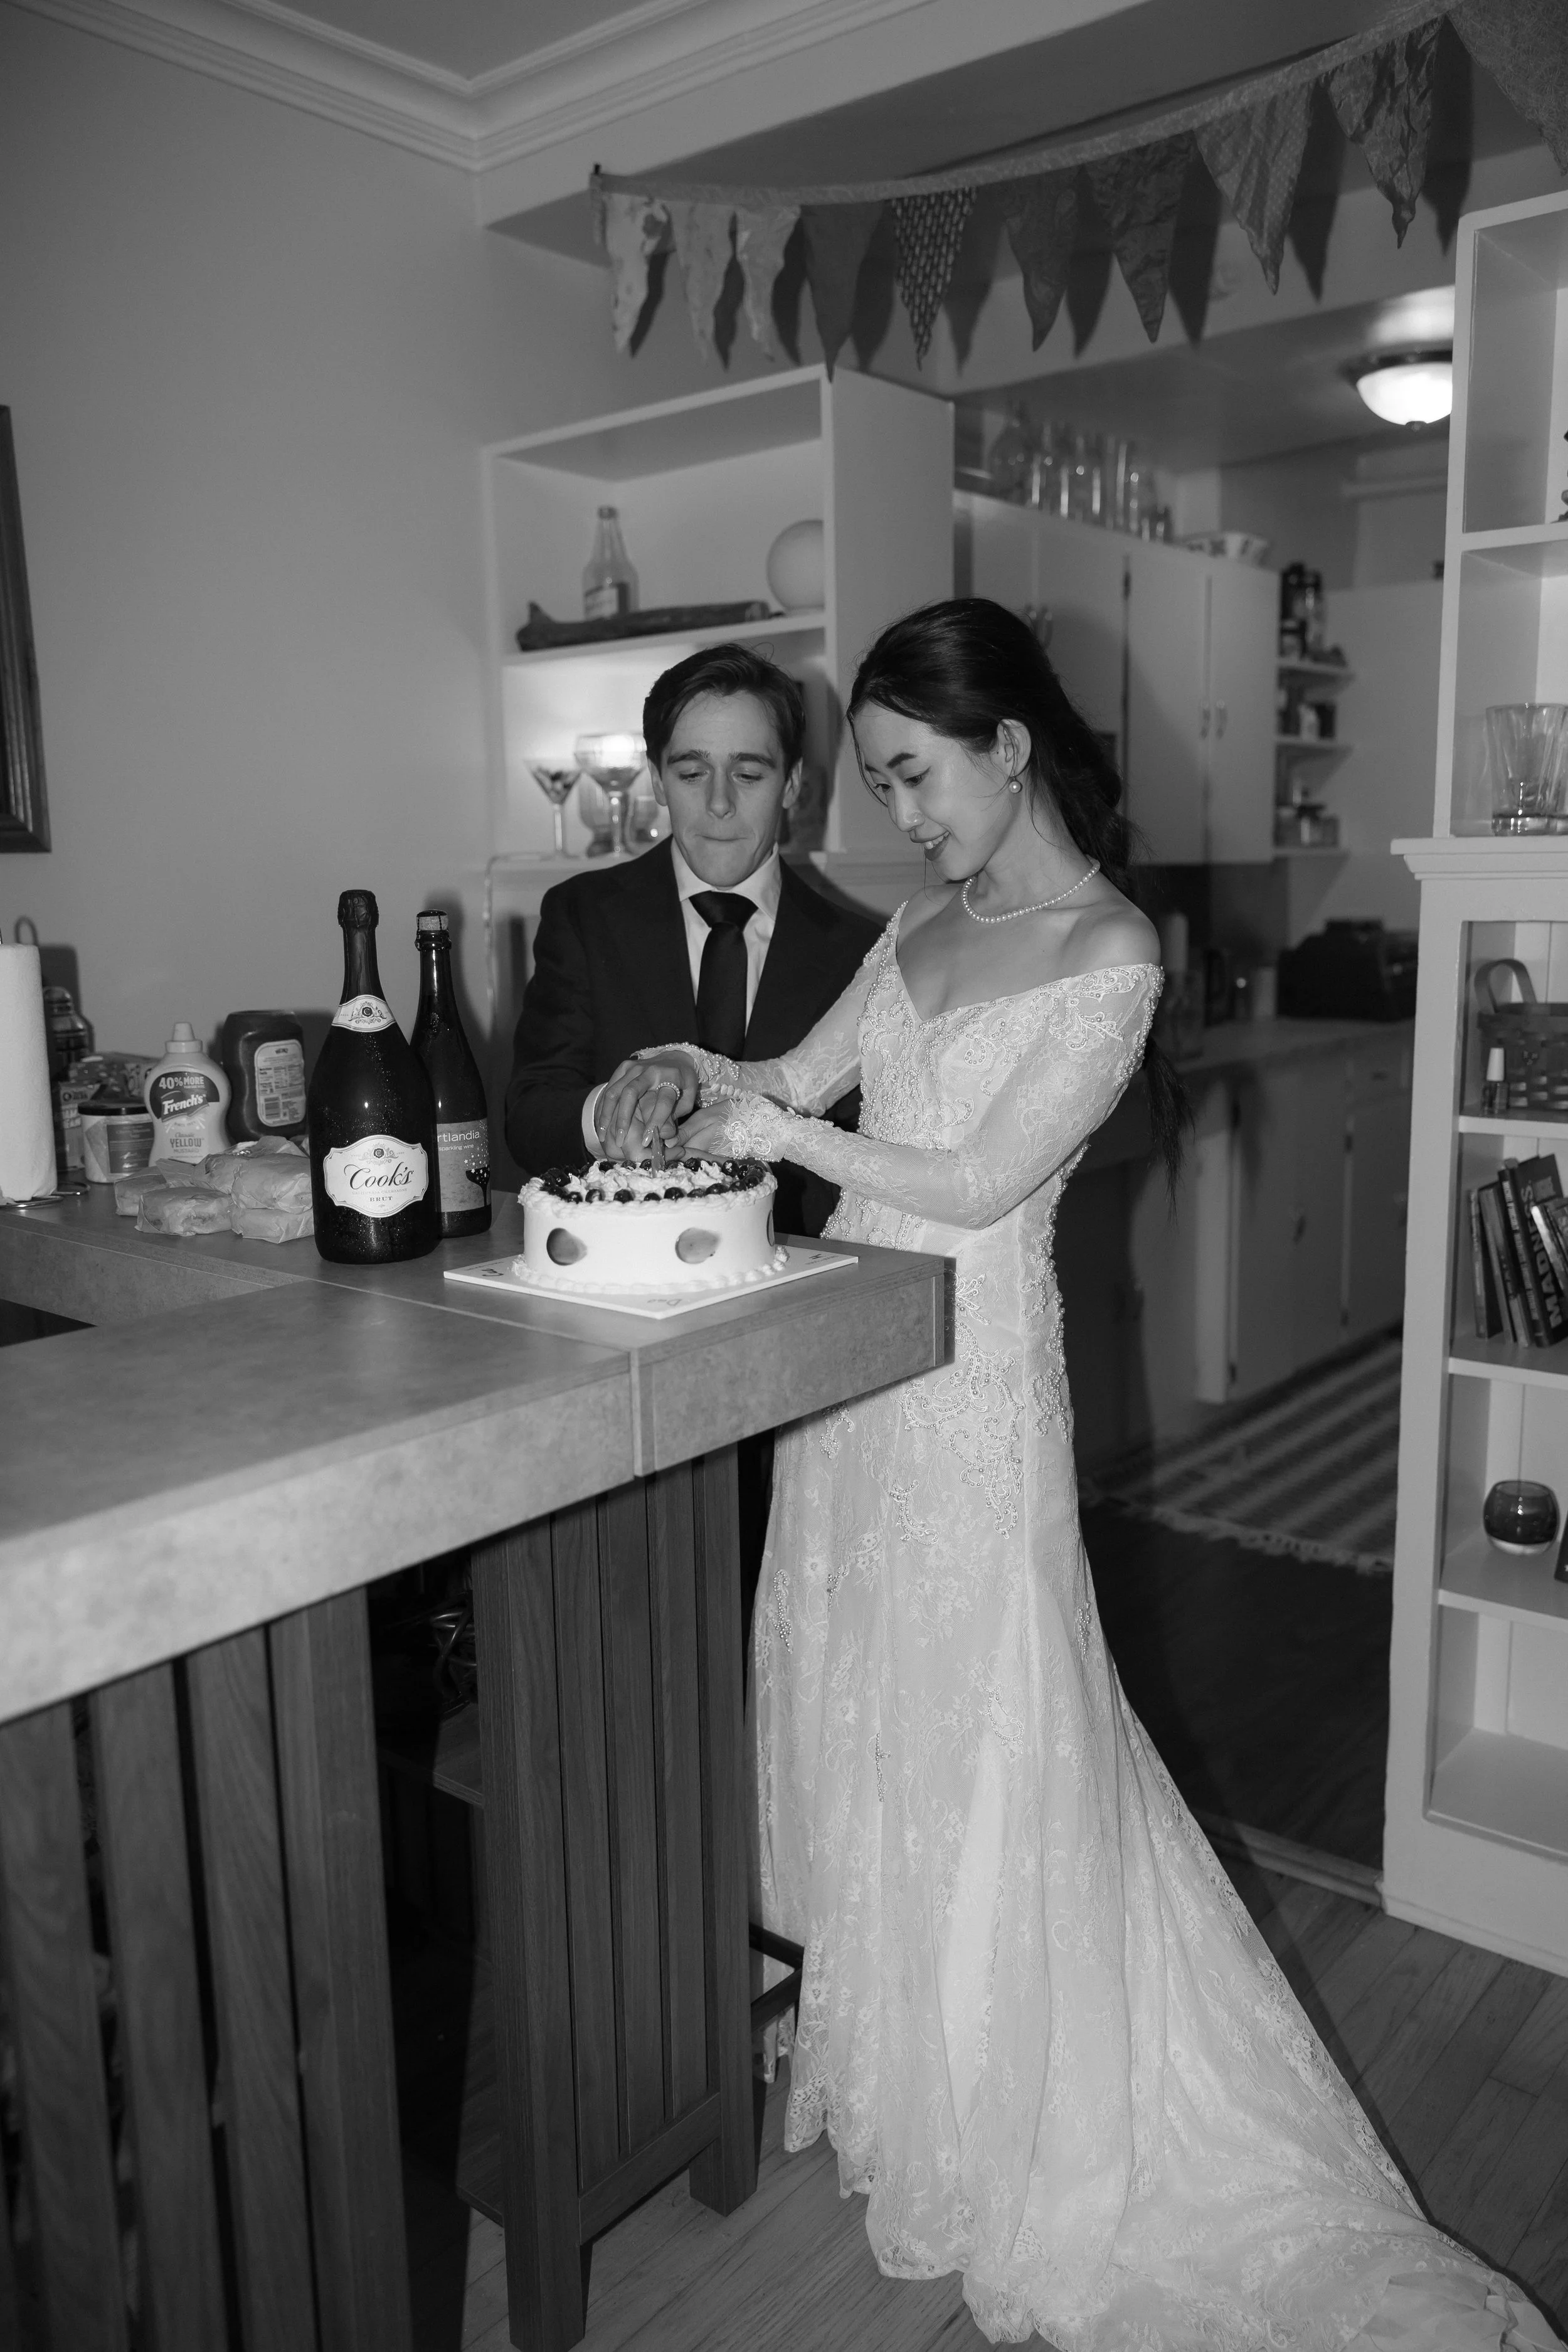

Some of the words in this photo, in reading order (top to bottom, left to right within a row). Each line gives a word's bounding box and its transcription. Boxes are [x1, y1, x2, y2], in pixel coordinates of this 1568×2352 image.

[159, 1077, 183, 1089] 40%
[183, 1076, 204, 1085] MORE
[170, 1138, 202, 1148] YELLOW
[344, 1162, 414, 1190] Cook's
